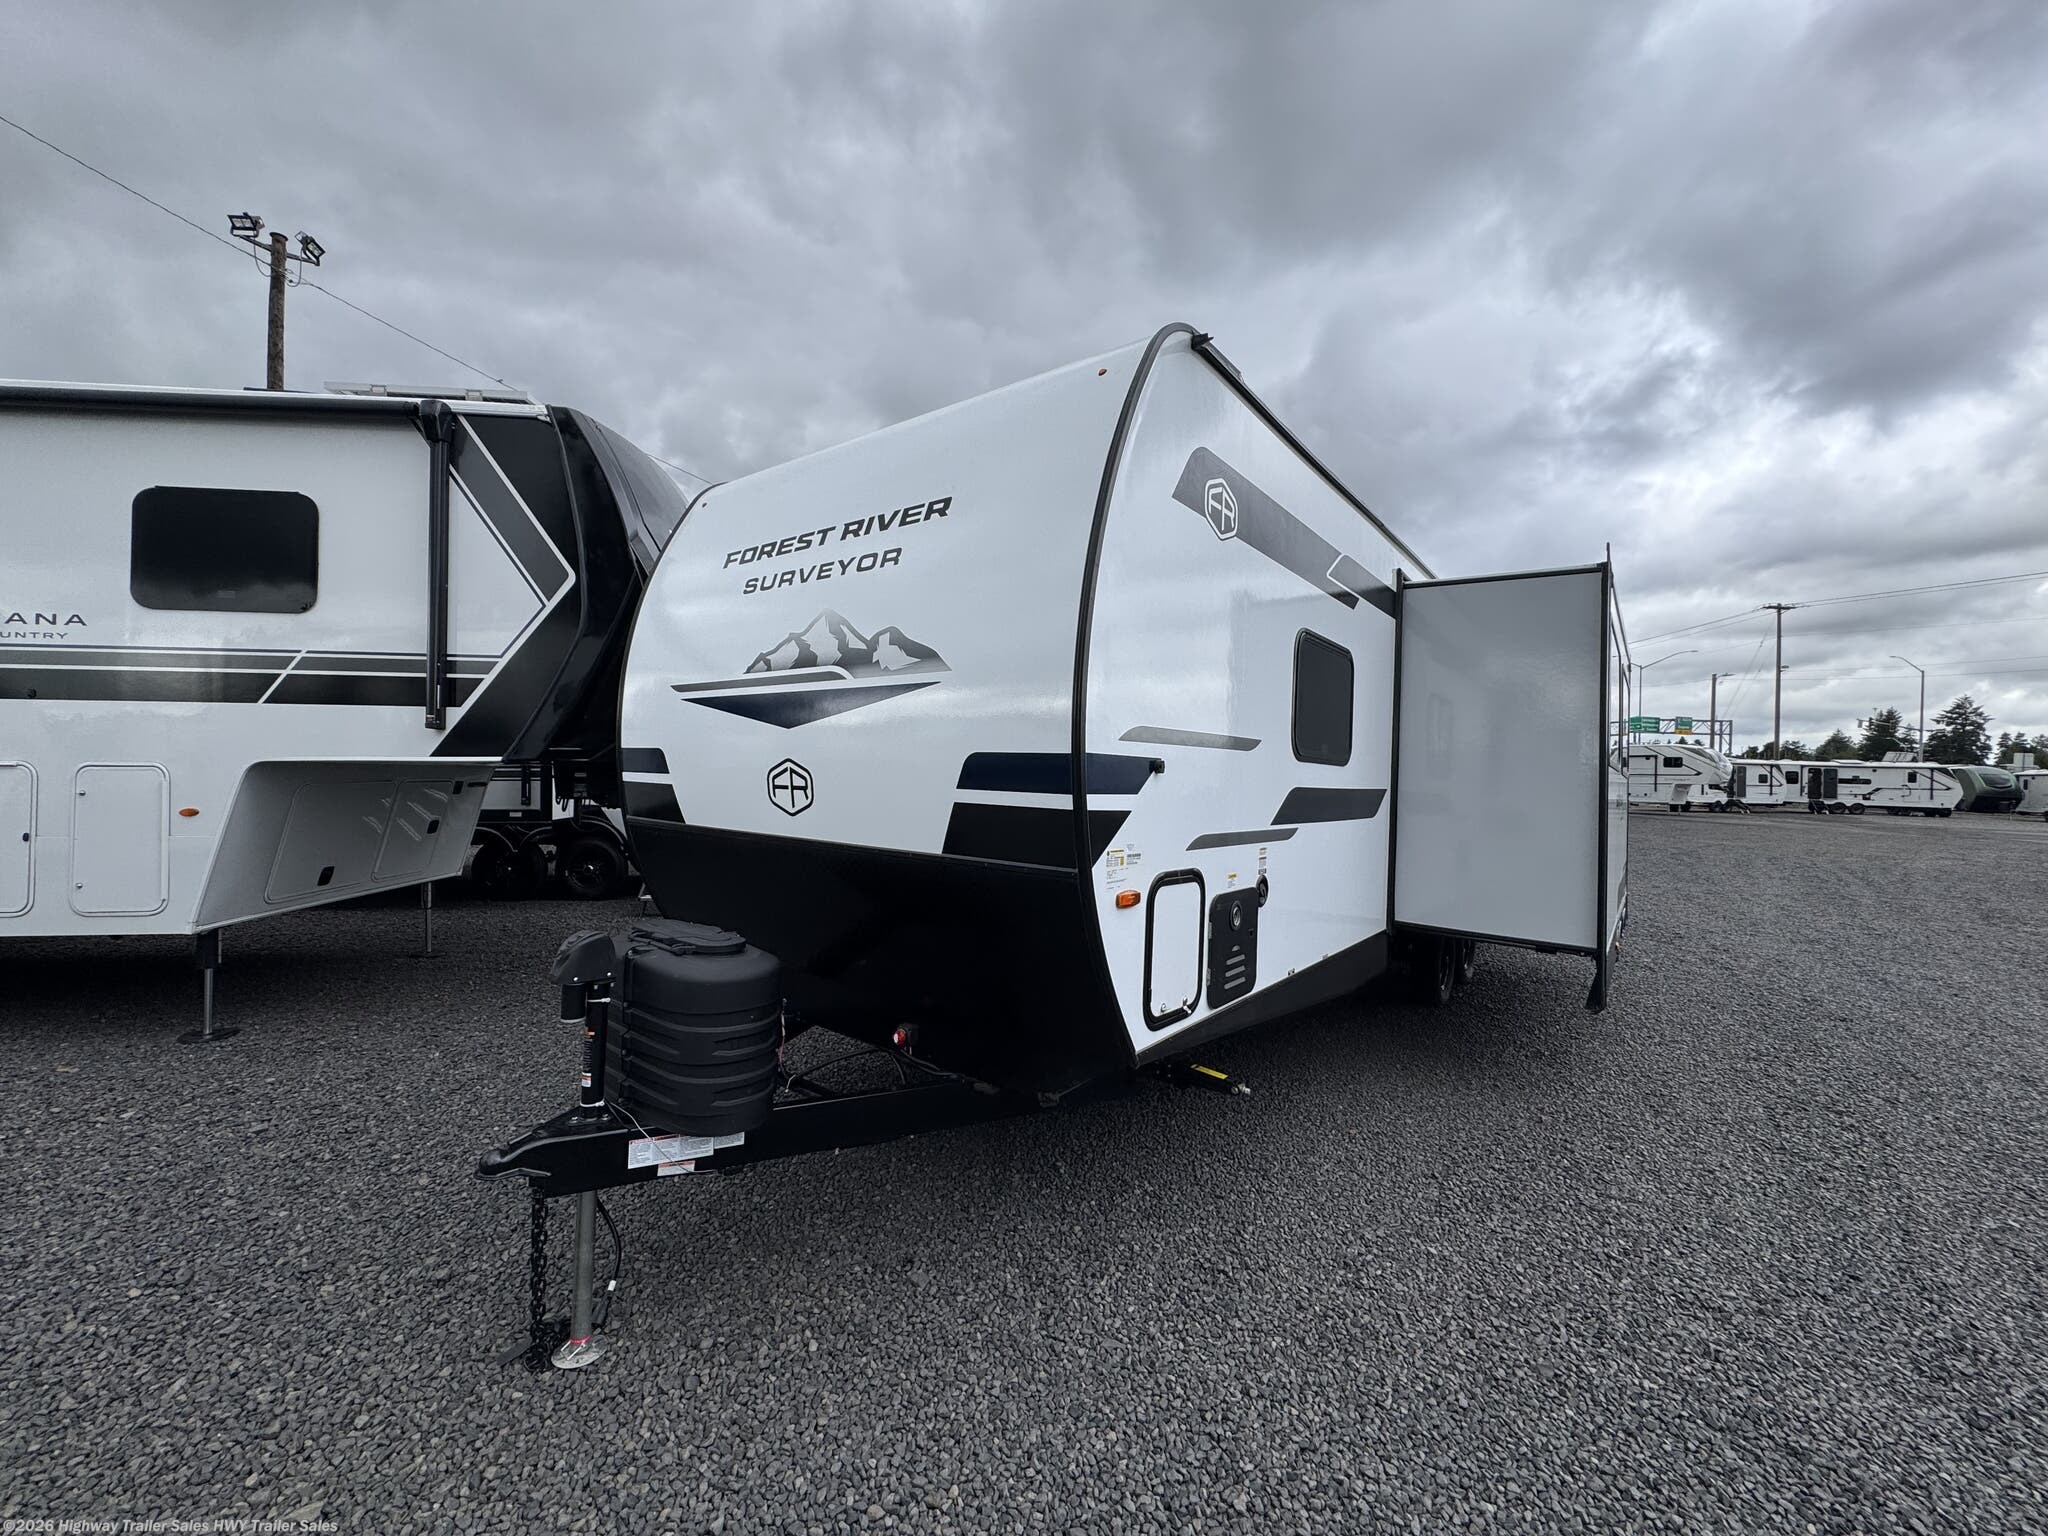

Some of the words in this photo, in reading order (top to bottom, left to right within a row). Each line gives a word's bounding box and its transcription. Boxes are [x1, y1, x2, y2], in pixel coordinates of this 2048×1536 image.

[722, 525, 837, 569] FOREST
[839, 496, 953, 541] RIVER
[742, 547, 903, 595] SURVEYOR
